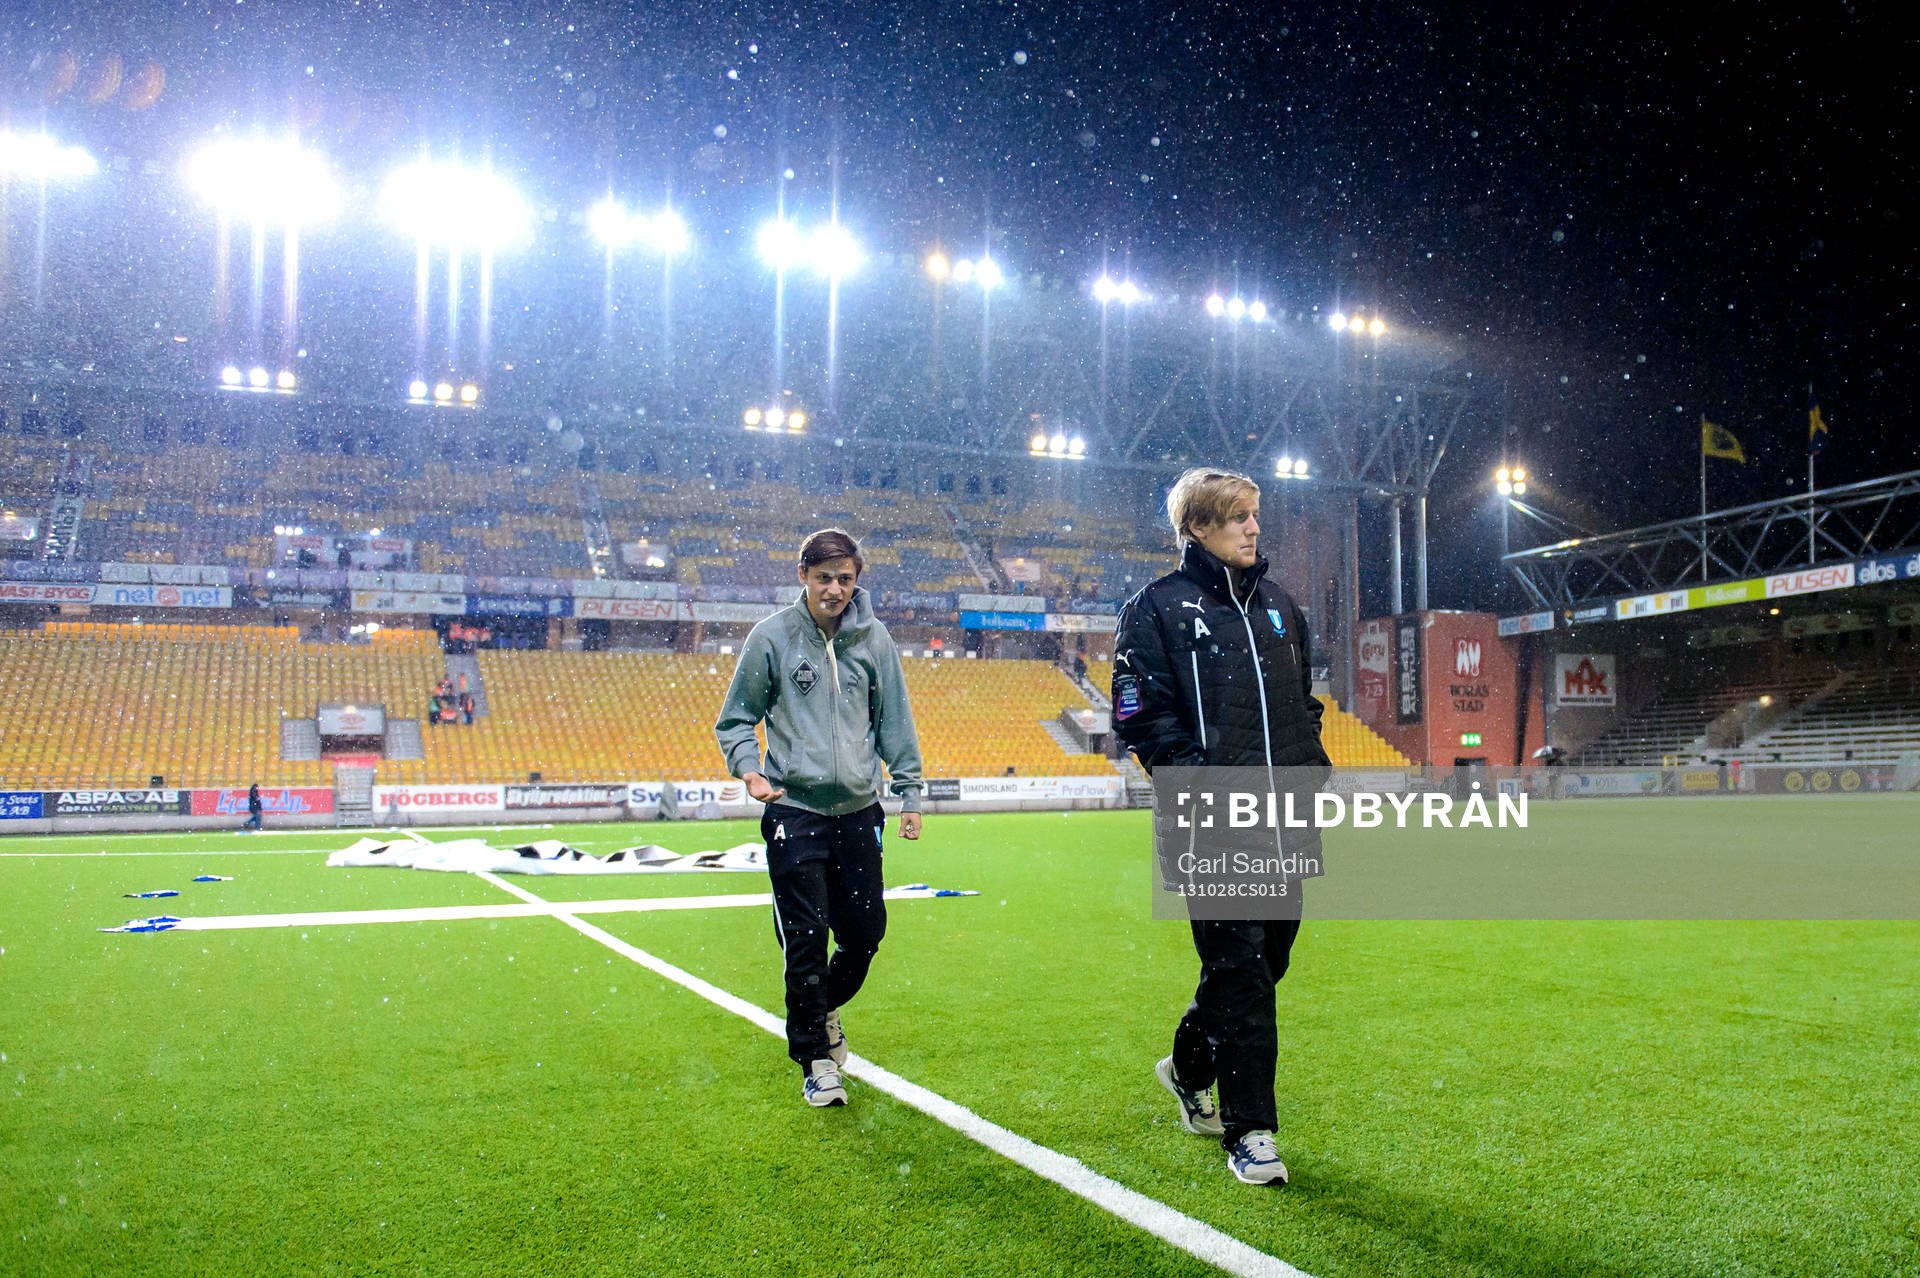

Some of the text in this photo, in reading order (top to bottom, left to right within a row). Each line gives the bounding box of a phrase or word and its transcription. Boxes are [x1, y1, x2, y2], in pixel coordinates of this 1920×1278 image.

[1772, 568, 1848, 594] PULSEN
[1859, 561, 1896, 584] ellos
[581, 600, 673, 618] PULSEN
[1194, 617, 1211, 639] A
[1565, 657, 1607, 695] MAK
[1453, 700, 1484, 713] STAD
[632, 788, 714, 803] Swtch
[963, 784, 1017, 793] SIMONSLAND
[57, 791, 179, 804] ASPA AB
[380, 789, 499, 806] HÖGBERGS
[773, 824, 786, 841] A
